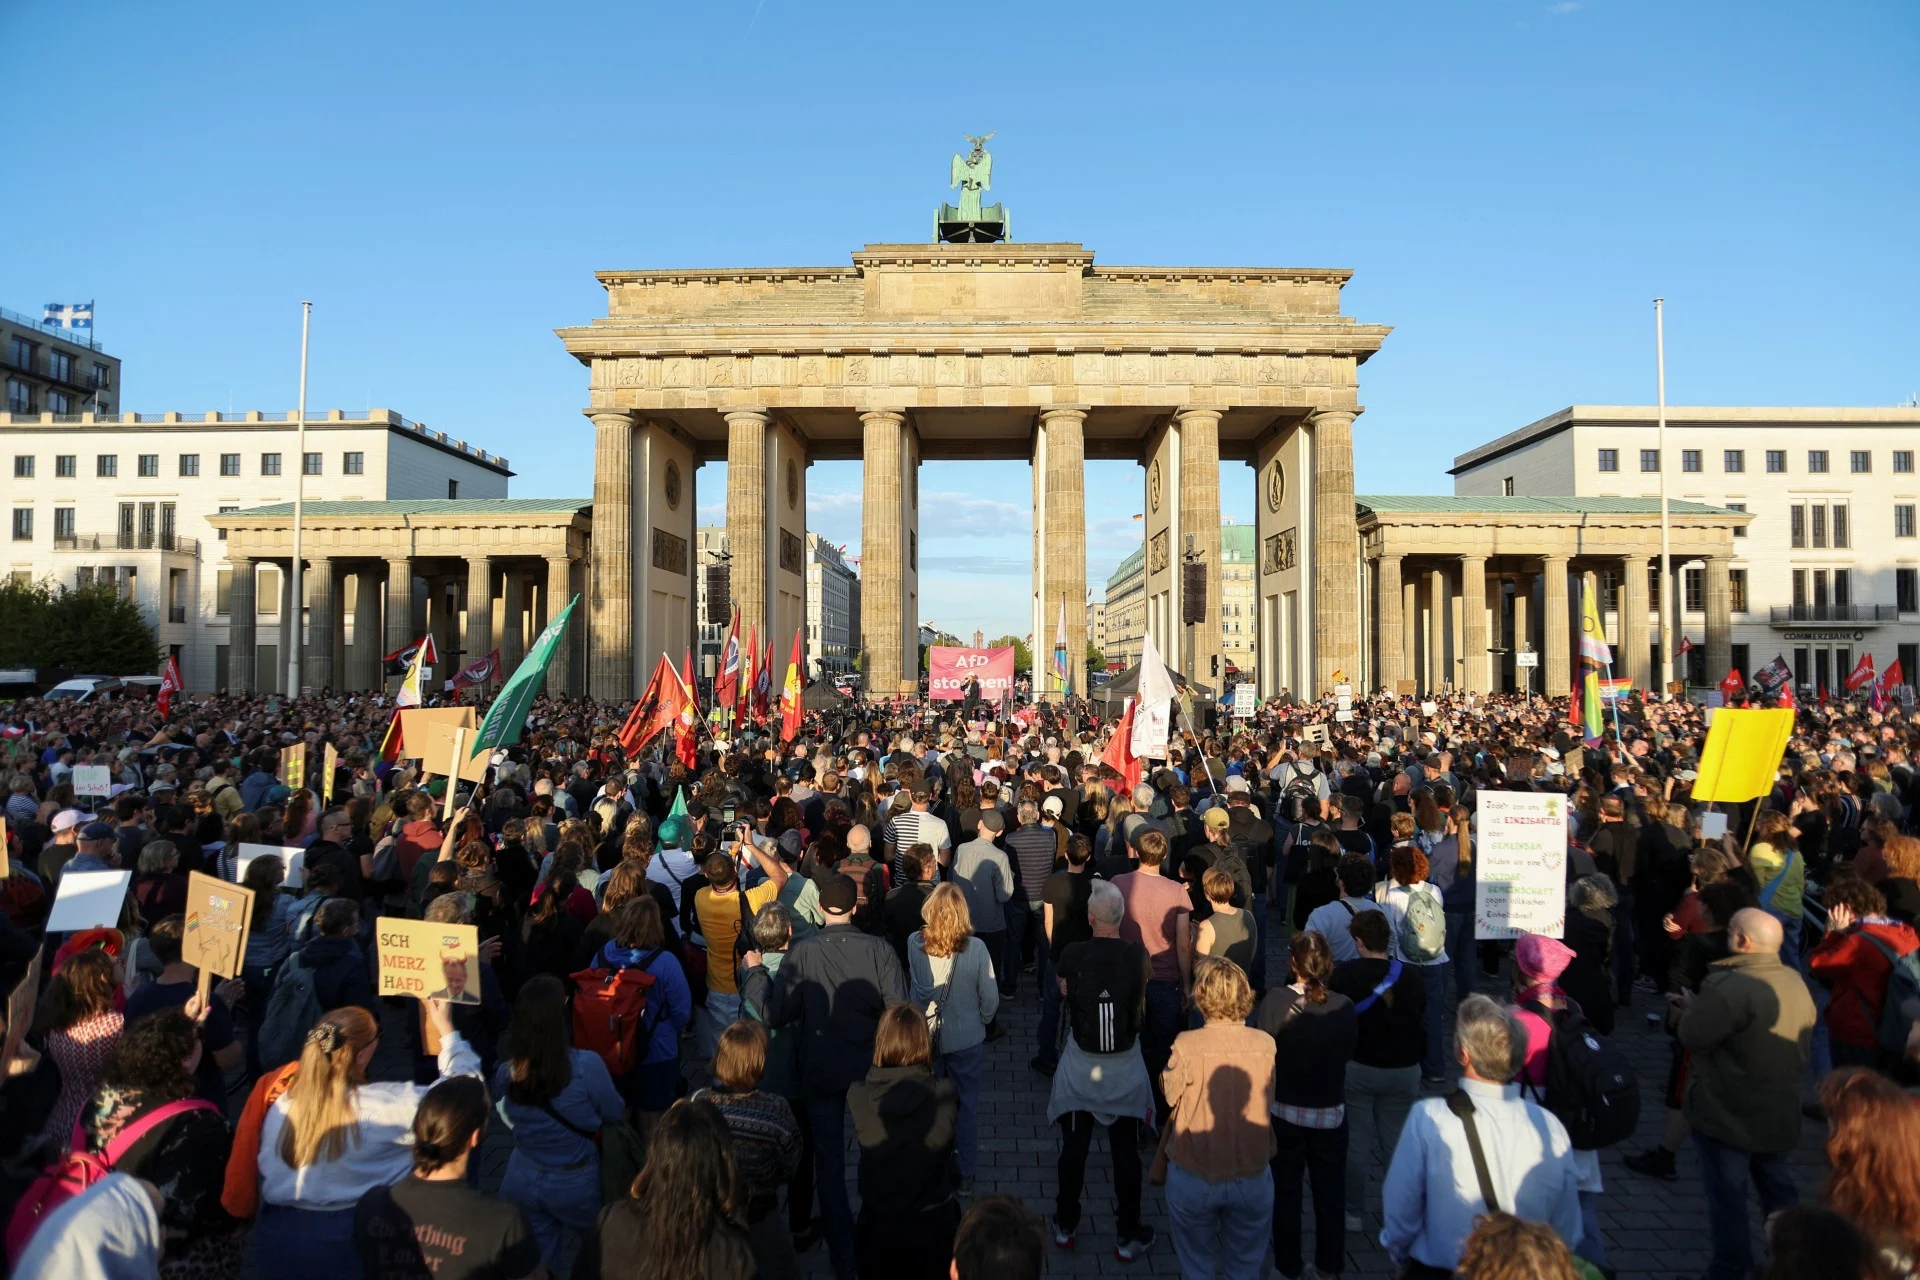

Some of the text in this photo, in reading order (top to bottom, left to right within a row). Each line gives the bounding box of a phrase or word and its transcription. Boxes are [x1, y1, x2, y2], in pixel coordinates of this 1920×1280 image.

[1783, 632, 1852, 640] COMMERZBANK
[955, 654, 989, 668] AfD
[933, 676, 1012, 689] stoen!
[1504, 816, 1561, 826] EINZIGARTIG
[1485, 896, 1507, 908] gegen
[380, 933, 410, 949] SCH
[382, 954, 425, 971] MERZ
[383, 974, 425, 992] HAFD
